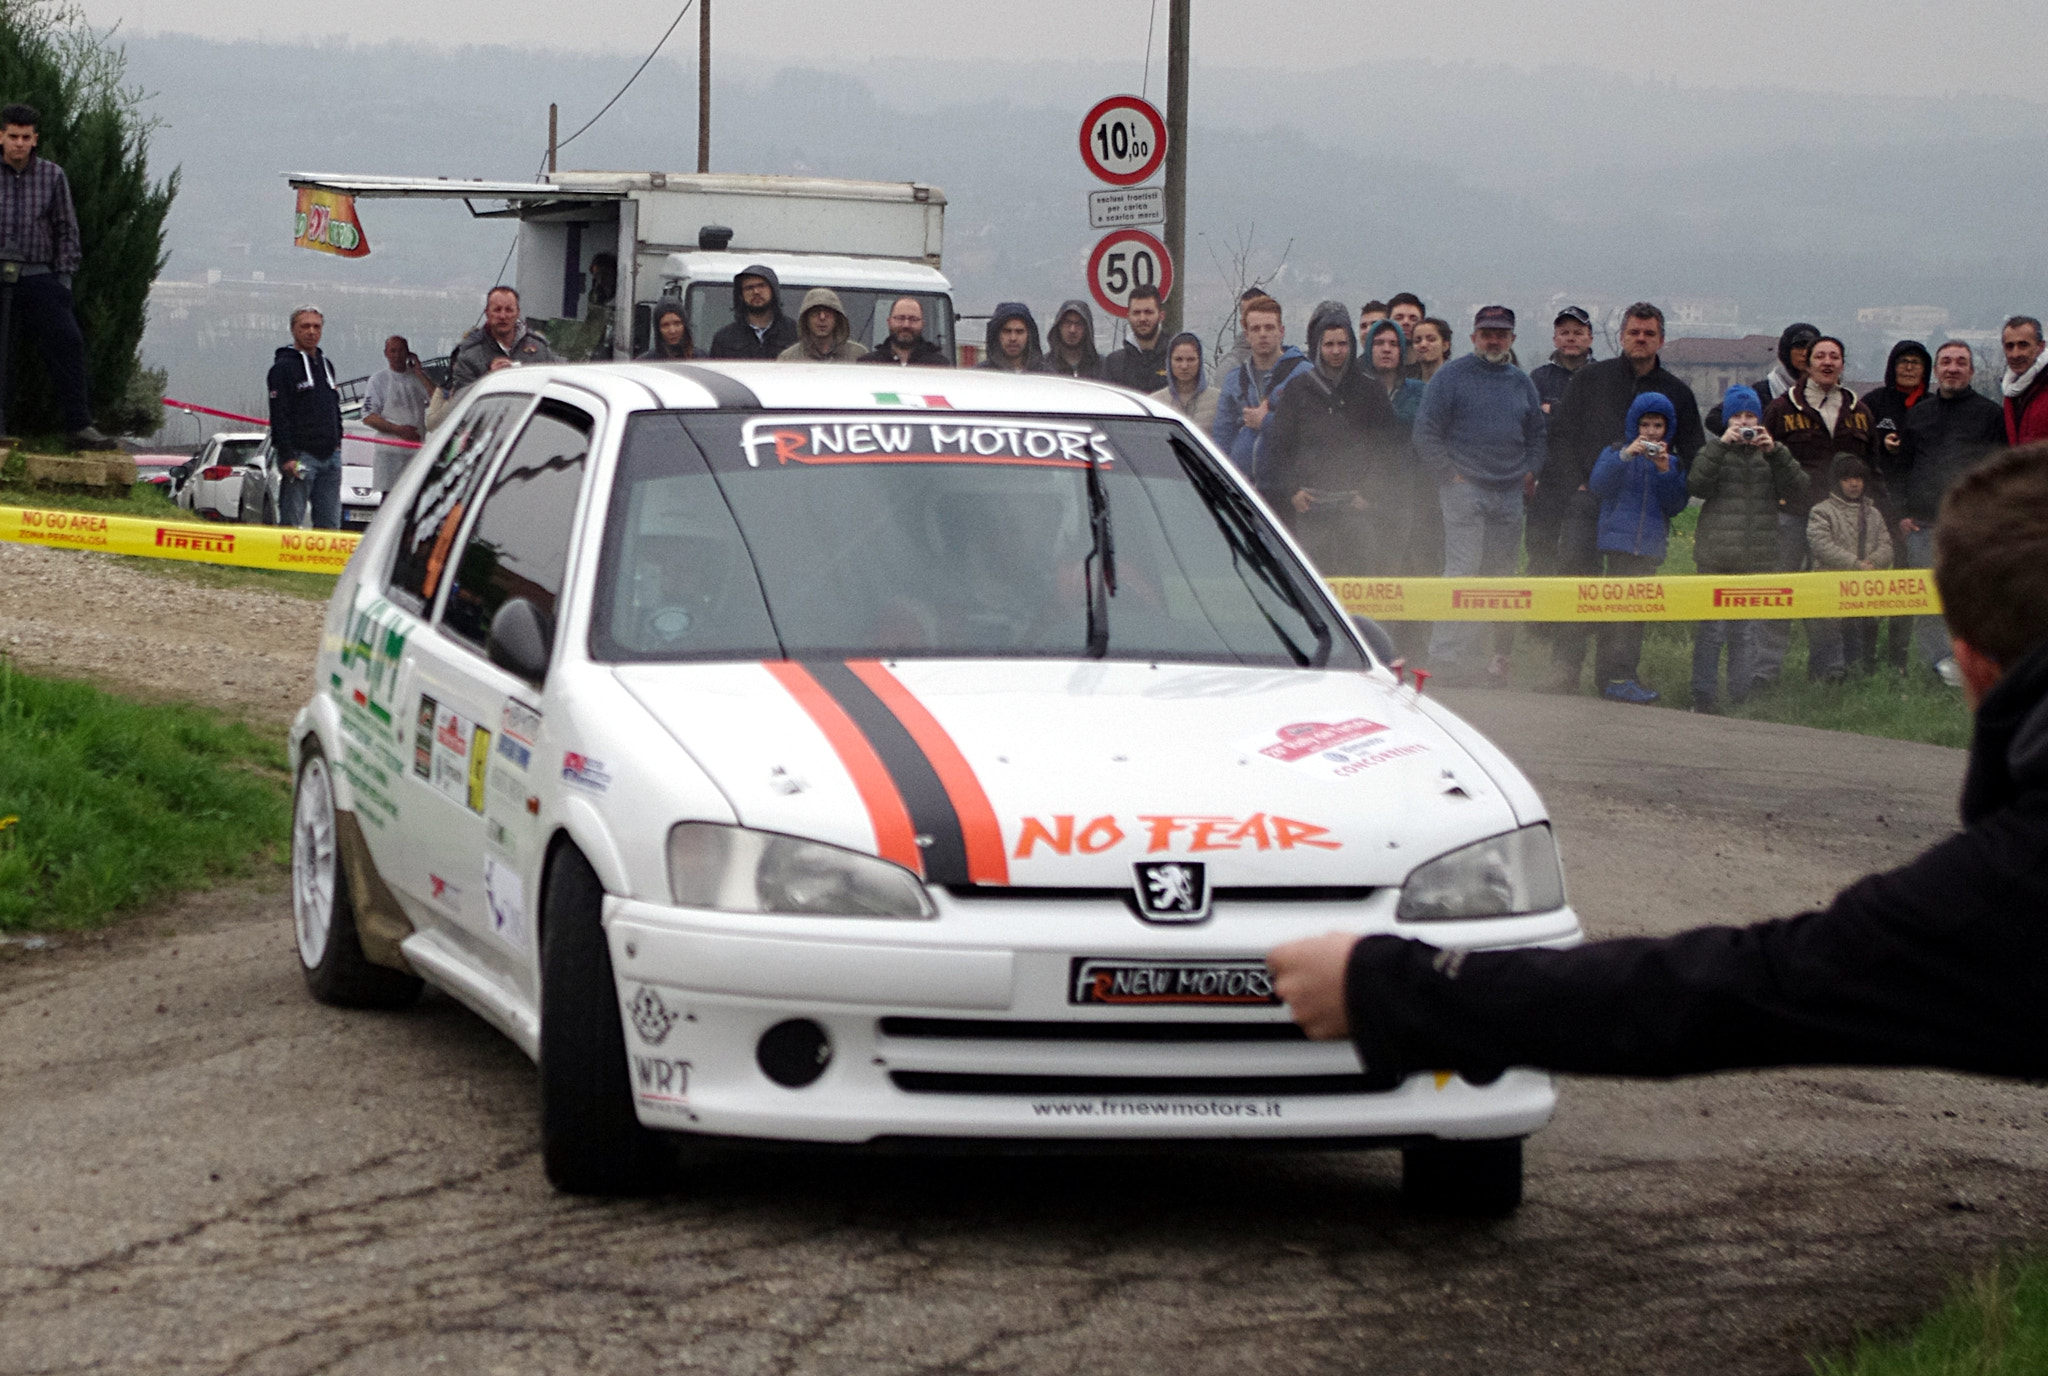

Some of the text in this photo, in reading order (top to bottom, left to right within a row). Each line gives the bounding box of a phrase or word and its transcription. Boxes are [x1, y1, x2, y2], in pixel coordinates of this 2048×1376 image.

[1096, 195, 1124, 204] esclusi
[1107, 203, 1148, 214] per carico
[1106, 213, 1135, 222] scarico
[1137, 211, 1159, 220] merci
[1106, 251, 1154, 294] 50
[929, 424, 1115, 463] MOTORS
[22, 511, 108, 532] NO GO AREA
[19, 529, 107, 546] ZONA PERICOLOSA
[155, 528, 235, 553] PIRELLI
[281, 534, 357, 554] NO GO ARE
[278, 553, 347, 567] ZONA PERICOL
[1342, 582, 1363, 600] GO
[1365, 582, 1404, 600] AREA
[1577, 583, 1665, 600] NO GO AREA
[1838, 578, 1927, 597] NO GO AREA
[1452, 589, 1532, 609] PIRELLI
[1713, 588, 1793, 607] PIRELLI
[1838, 599, 1928, 610] ZONA PERICOLOSA
[1576, 603, 1666, 613] ZONA PERICOLOSA
[1012, 812, 1344, 860] NO FEAR
[1176, 969, 1274, 997] MOTORS
[633, 1055, 693, 1095] WRT
[1032, 1099, 1283, 1118] www.frnewmotors.it
